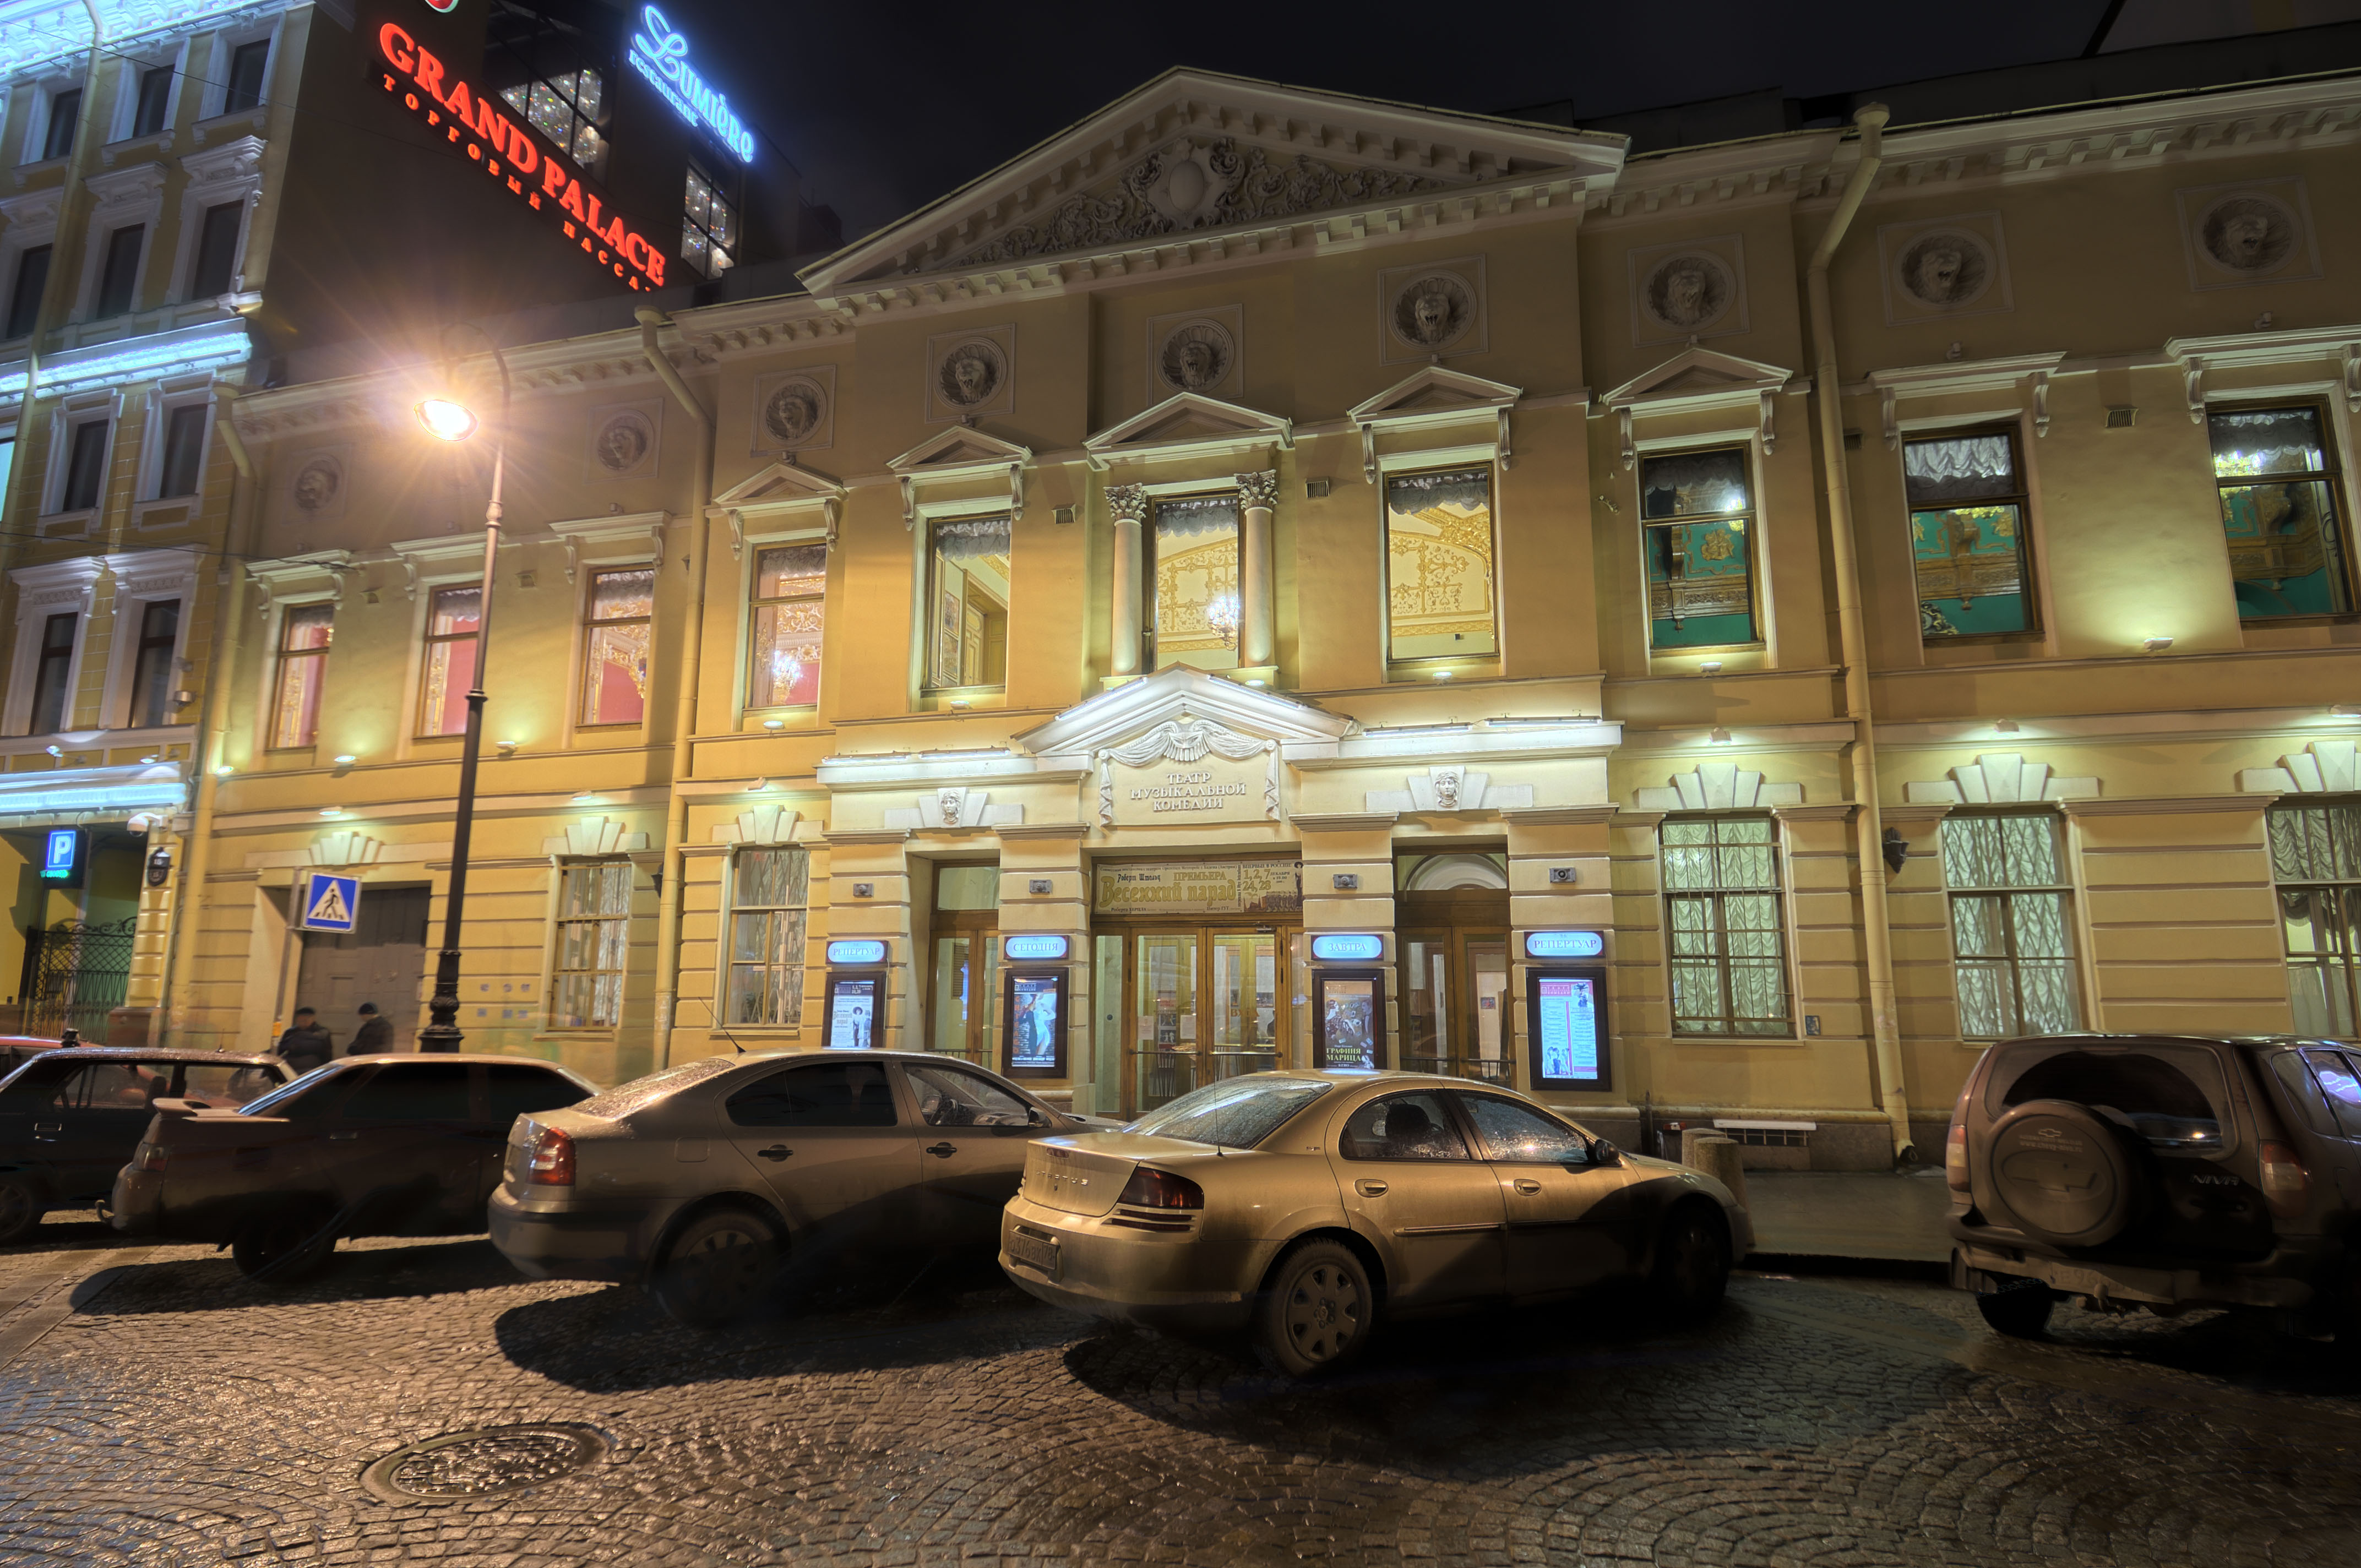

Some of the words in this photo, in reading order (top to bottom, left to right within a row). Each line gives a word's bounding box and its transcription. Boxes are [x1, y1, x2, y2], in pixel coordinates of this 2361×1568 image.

[629, 48, 698, 127] restaurant
[380, 23, 537, 173] GRAND
[542, 155, 666, 287] PALACE
[384, 74, 541, 211] ТОРГОВЫЙ
[563, 220, 651, 292] ПАССА
[1167, 772, 1211, 785] ТЕАТР
[1130, 782, 1247, 801] МУЗЫКАЛЬНОЙ
[1152, 798, 1223, 812] КОМЕДИИ
[53, 835, 72, 864] P
[1117, 873, 1136, 883] Роберт
[1139, 873, 1161, 882] Штольц
[1173, 871, 1227, 881] ПРЕМЬЕРА
[1264, 869, 1271, 879] 7
[1099, 876, 1182, 908] Весенний
[1187, 879, 1236, 907] парад
[1013, 943, 1058, 952] СЕГОДНЯ
[1328, 943, 1367, 951] ЗАВТРА
[1534, 939, 1597, 949] РЕПЕРТУАР
[833, 948, 880, 956] РЕПЕРТУАР
[1035, 1171, 1089, 1185] STRATUS
[2189, 1174, 2239, 1186] NIVA
